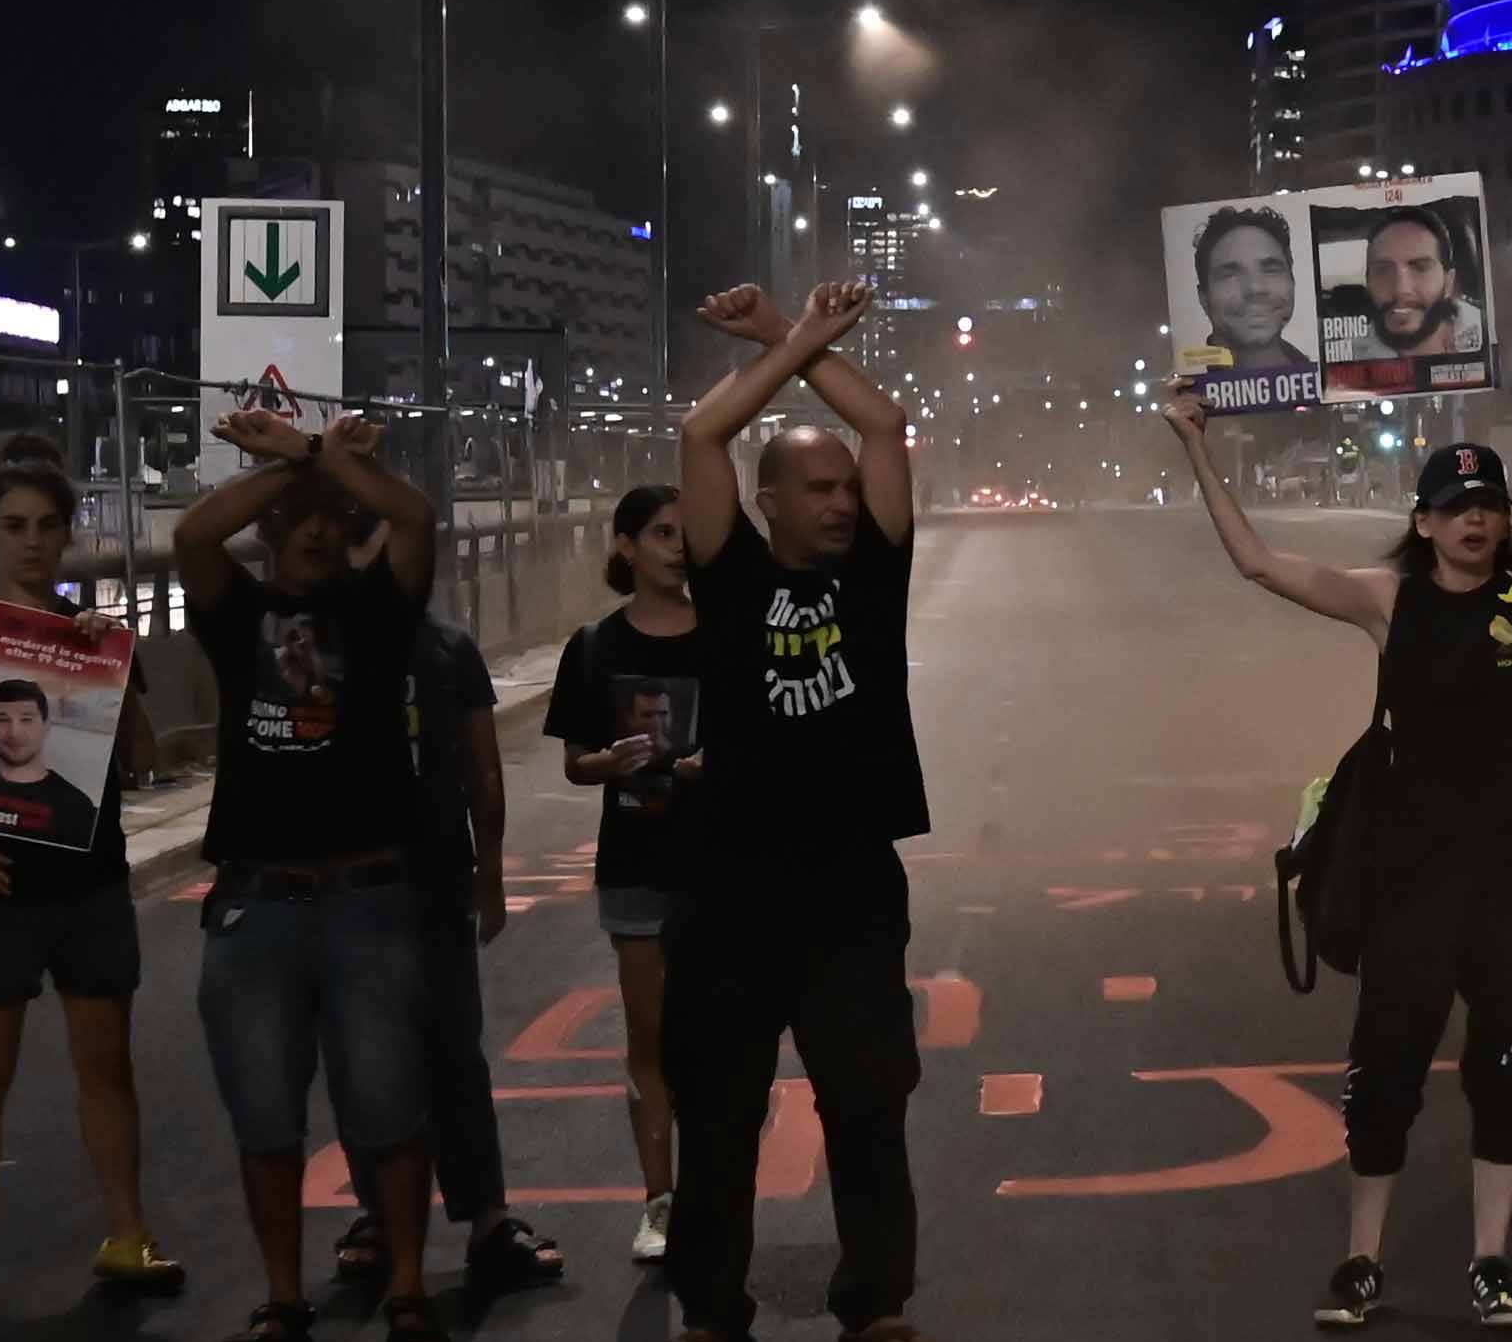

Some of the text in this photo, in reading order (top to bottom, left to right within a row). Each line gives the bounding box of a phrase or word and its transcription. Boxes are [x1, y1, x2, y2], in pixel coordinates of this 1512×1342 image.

[1322, 315, 1368, 340] BRING
[1324, 339, 1353, 364] HIM
[1205, 379, 1271, 409] BRING
[1456, 449, 1479, 475] B
[0, 634, 57, 655] murdered
[59, 643, 72, 656] in
[73, 650, 123, 669] captivity
[4, 647, 83, 672] after 99 days
